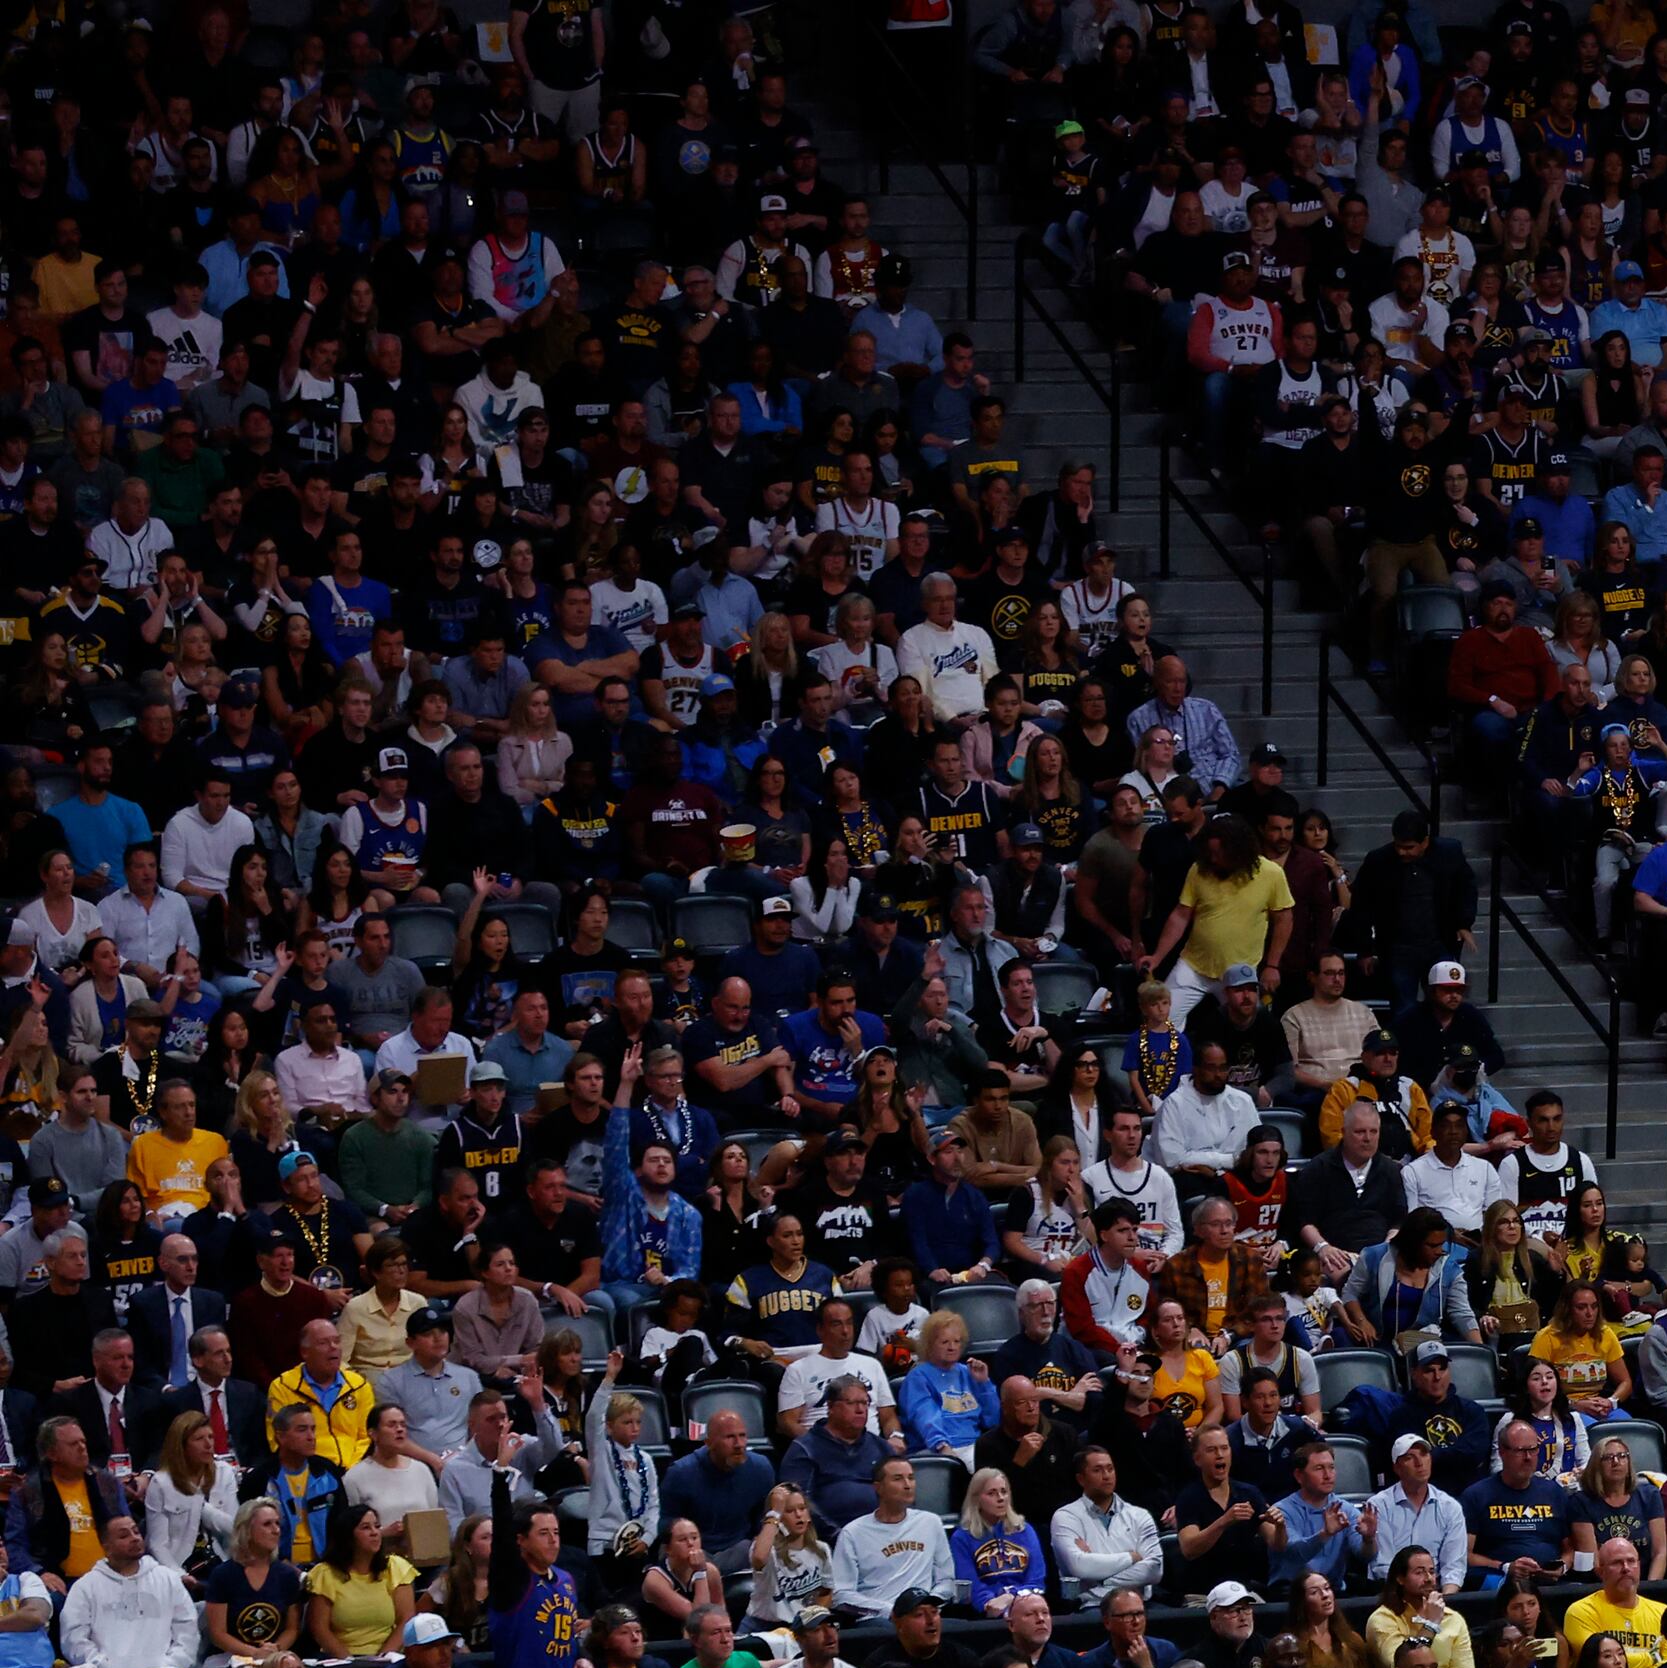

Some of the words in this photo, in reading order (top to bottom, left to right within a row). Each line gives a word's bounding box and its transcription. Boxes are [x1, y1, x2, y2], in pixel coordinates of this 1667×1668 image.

[1221, 323, 1269, 339] DENVER
[1492, 464, 1534, 478] DENVER
[1501, 484, 1524, 502] 27
[1603, 587, 1646, 604] NUGGETS
[671, 692, 698, 713] 27
[930, 811, 982, 832] DENVER
[464, 1148, 518, 1168] DENVER
[486, 1171, 500, 1197] 8
[1135, 1200, 1158, 1224] 27
[1259, 1203, 1281, 1226] 27
[1598, 1515, 1642, 1533] DENVER
[881, 1541, 925, 1559] DENVER
[553, 1614, 572, 1642] 15
[545, 1641, 572, 1659] CITY
